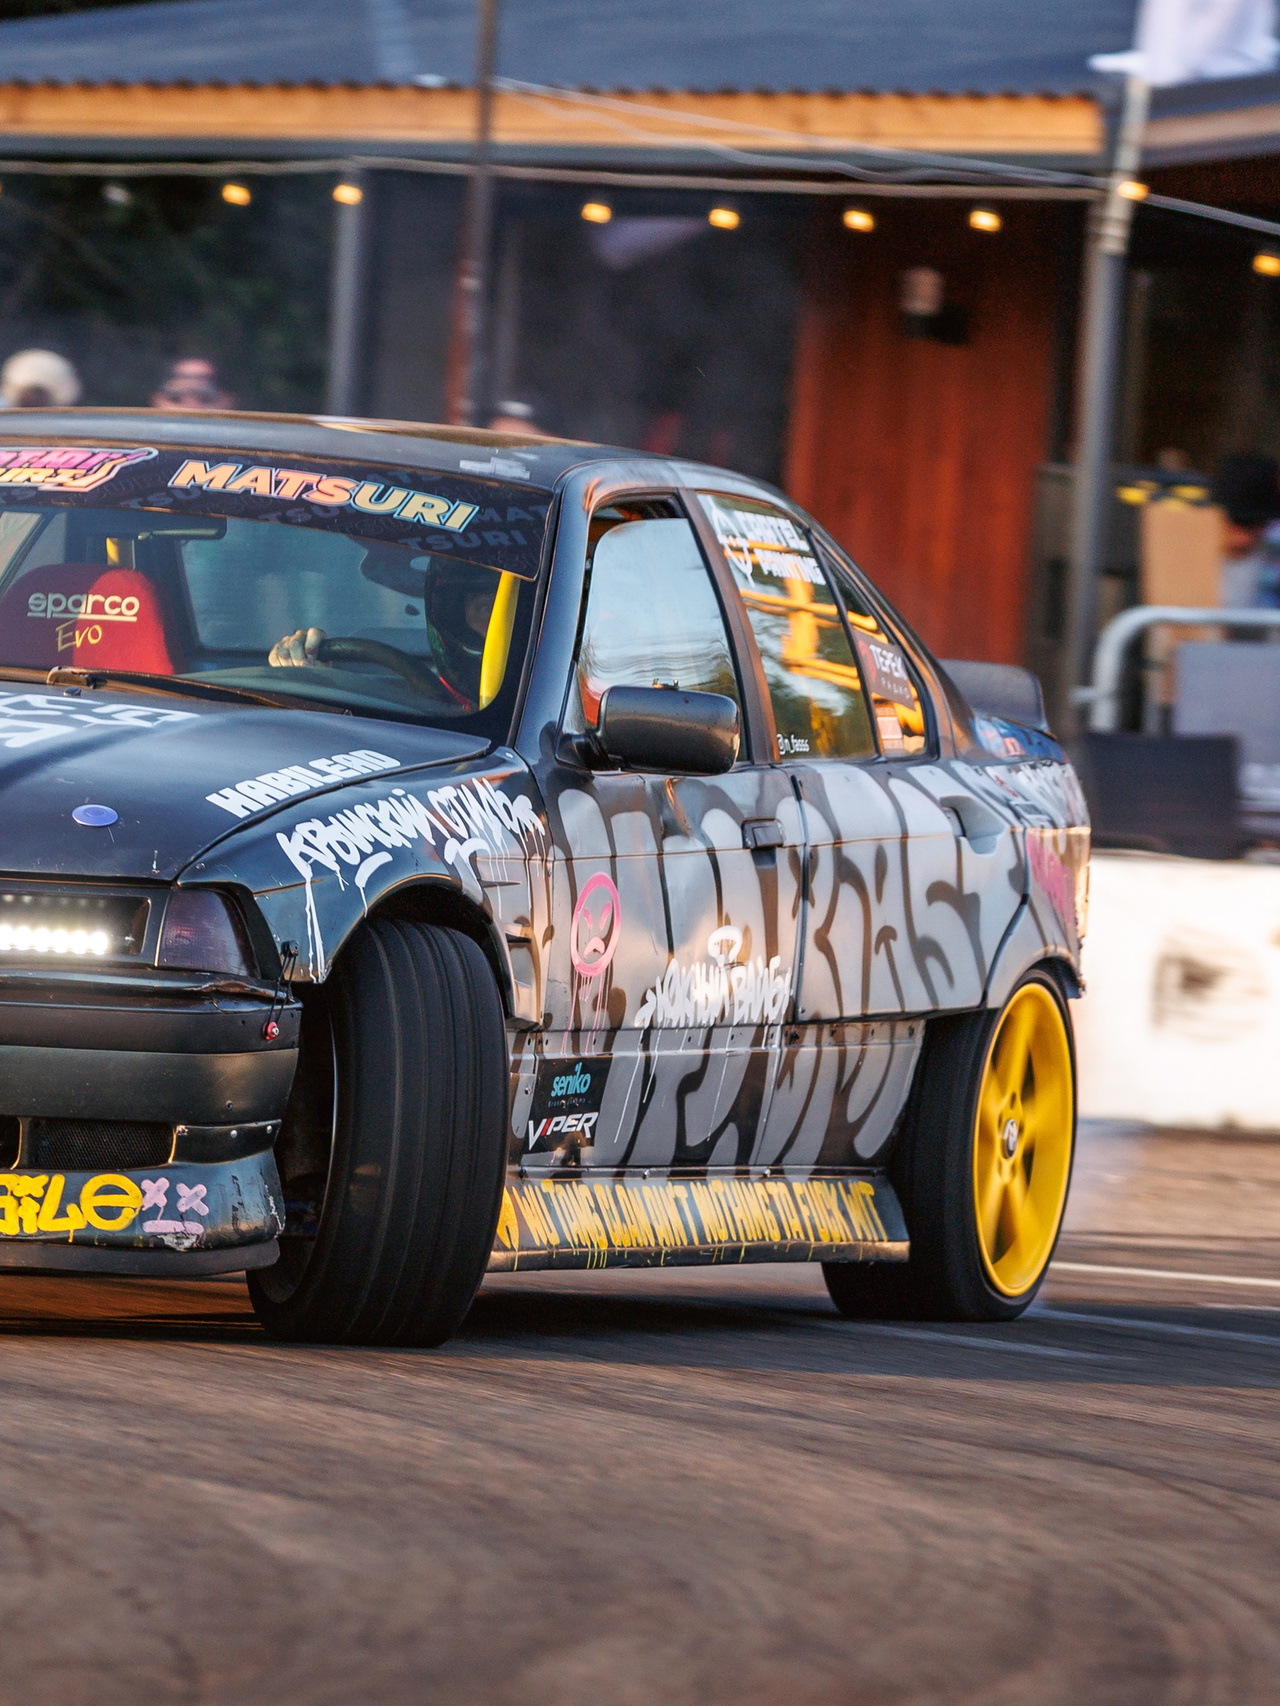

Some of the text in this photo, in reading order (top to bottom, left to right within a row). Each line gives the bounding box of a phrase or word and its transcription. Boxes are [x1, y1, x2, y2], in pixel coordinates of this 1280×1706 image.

[169, 459, 480, 534] MATSURI
[27, 591, 140, 621] sparco
[205, 749, 401, 818] HABILEAD
[551, 1062, 591, 1097] seniko
[528, 1111, 599, 1151] VIPER
